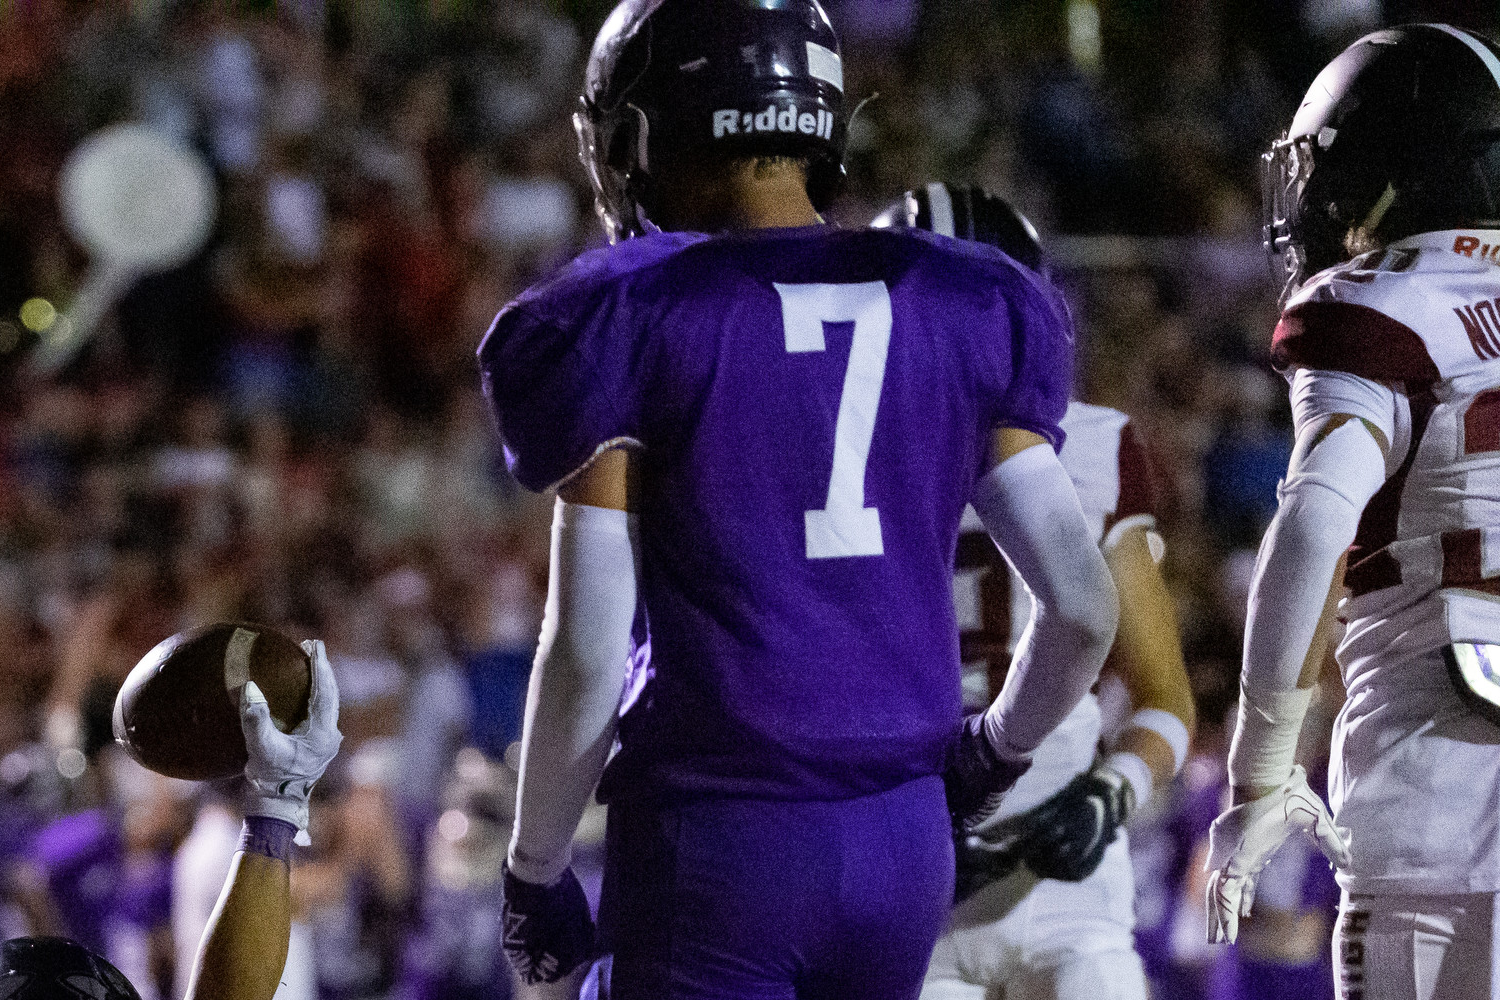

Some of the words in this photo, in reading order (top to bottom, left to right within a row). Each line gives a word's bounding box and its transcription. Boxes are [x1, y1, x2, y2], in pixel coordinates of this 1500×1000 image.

[712, 104, 834, 140] Riddell
[1453, 297, 1500, 362] NO
[772, 279, 893, 559] 7
